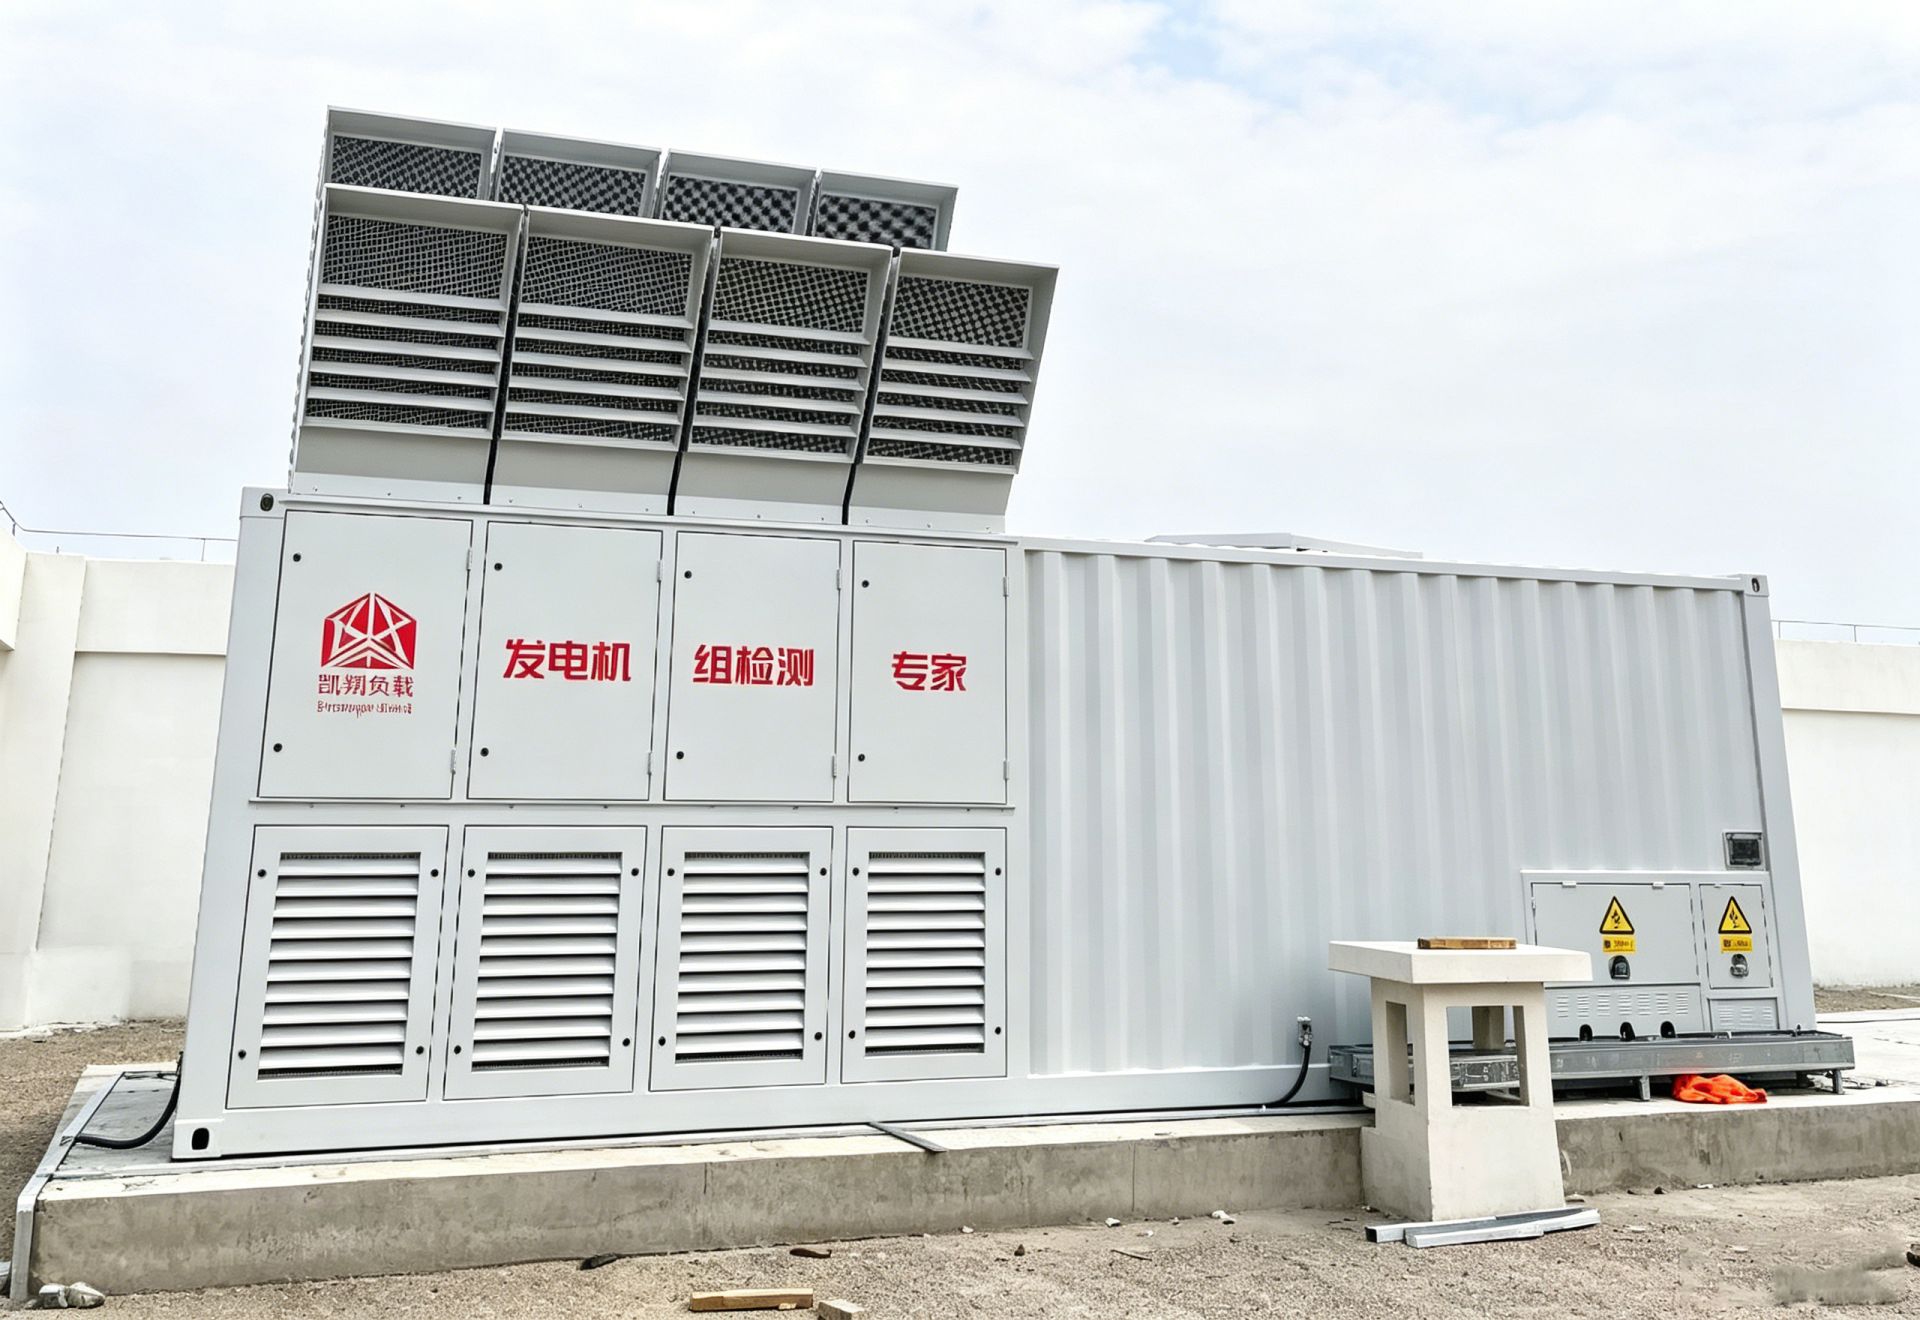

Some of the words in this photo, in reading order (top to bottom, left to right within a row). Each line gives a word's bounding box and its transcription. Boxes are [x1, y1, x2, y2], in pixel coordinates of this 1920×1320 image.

[503, 638, 632, 682] 发电机
[692, 643, 815, 688] 组检测
[891, 649, 968, 693] 专家
[318, 674, 415, 698] 凯翔负载
